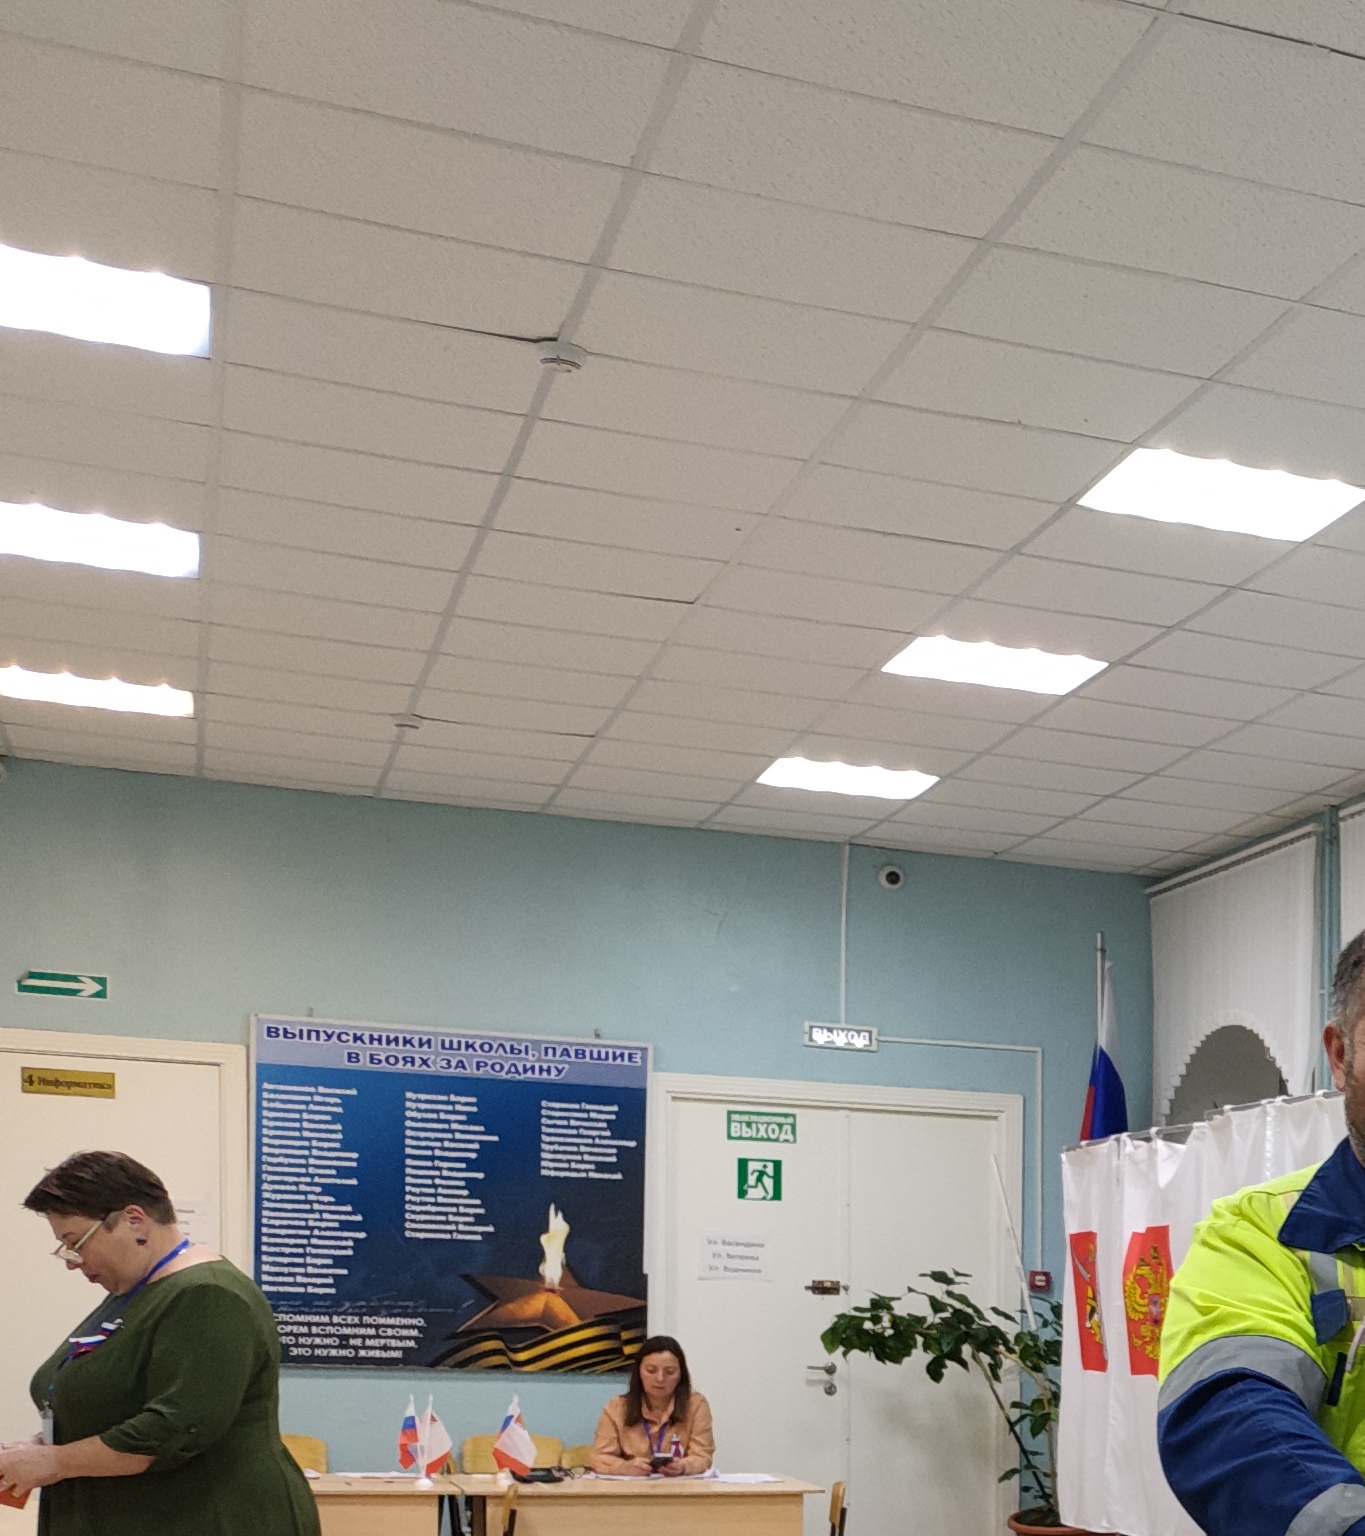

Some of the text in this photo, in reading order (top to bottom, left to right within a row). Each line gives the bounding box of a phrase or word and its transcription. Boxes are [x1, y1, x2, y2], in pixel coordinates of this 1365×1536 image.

[265, 1025, 641, 1064] ВЫПУСКНИКИ ШКОЛЫ, ПАВШИЕ
[811, 1027, 871, 1047] ВЫХОД
[346, 1051, 567, 1078] В БОЯХ ЗА РОДИНУ
[730, 1122, 795, 1143] ВЫХОД
[273, 1313, 330, 1324] СПОМНИМ
[332, 1315, 361, 1325] ВСЕХ
[277, 1325, 308, 1334] ОРЕМ
[279, 1336, 296, 1345] ТО
[298, 1336, 340, 1346] НУЖНО
[348, 1338, 363, 1347] НЕ
[288, 1347, 313, 1357] ЭТО
[314, 1347, 356, 1358] НУЖНО
